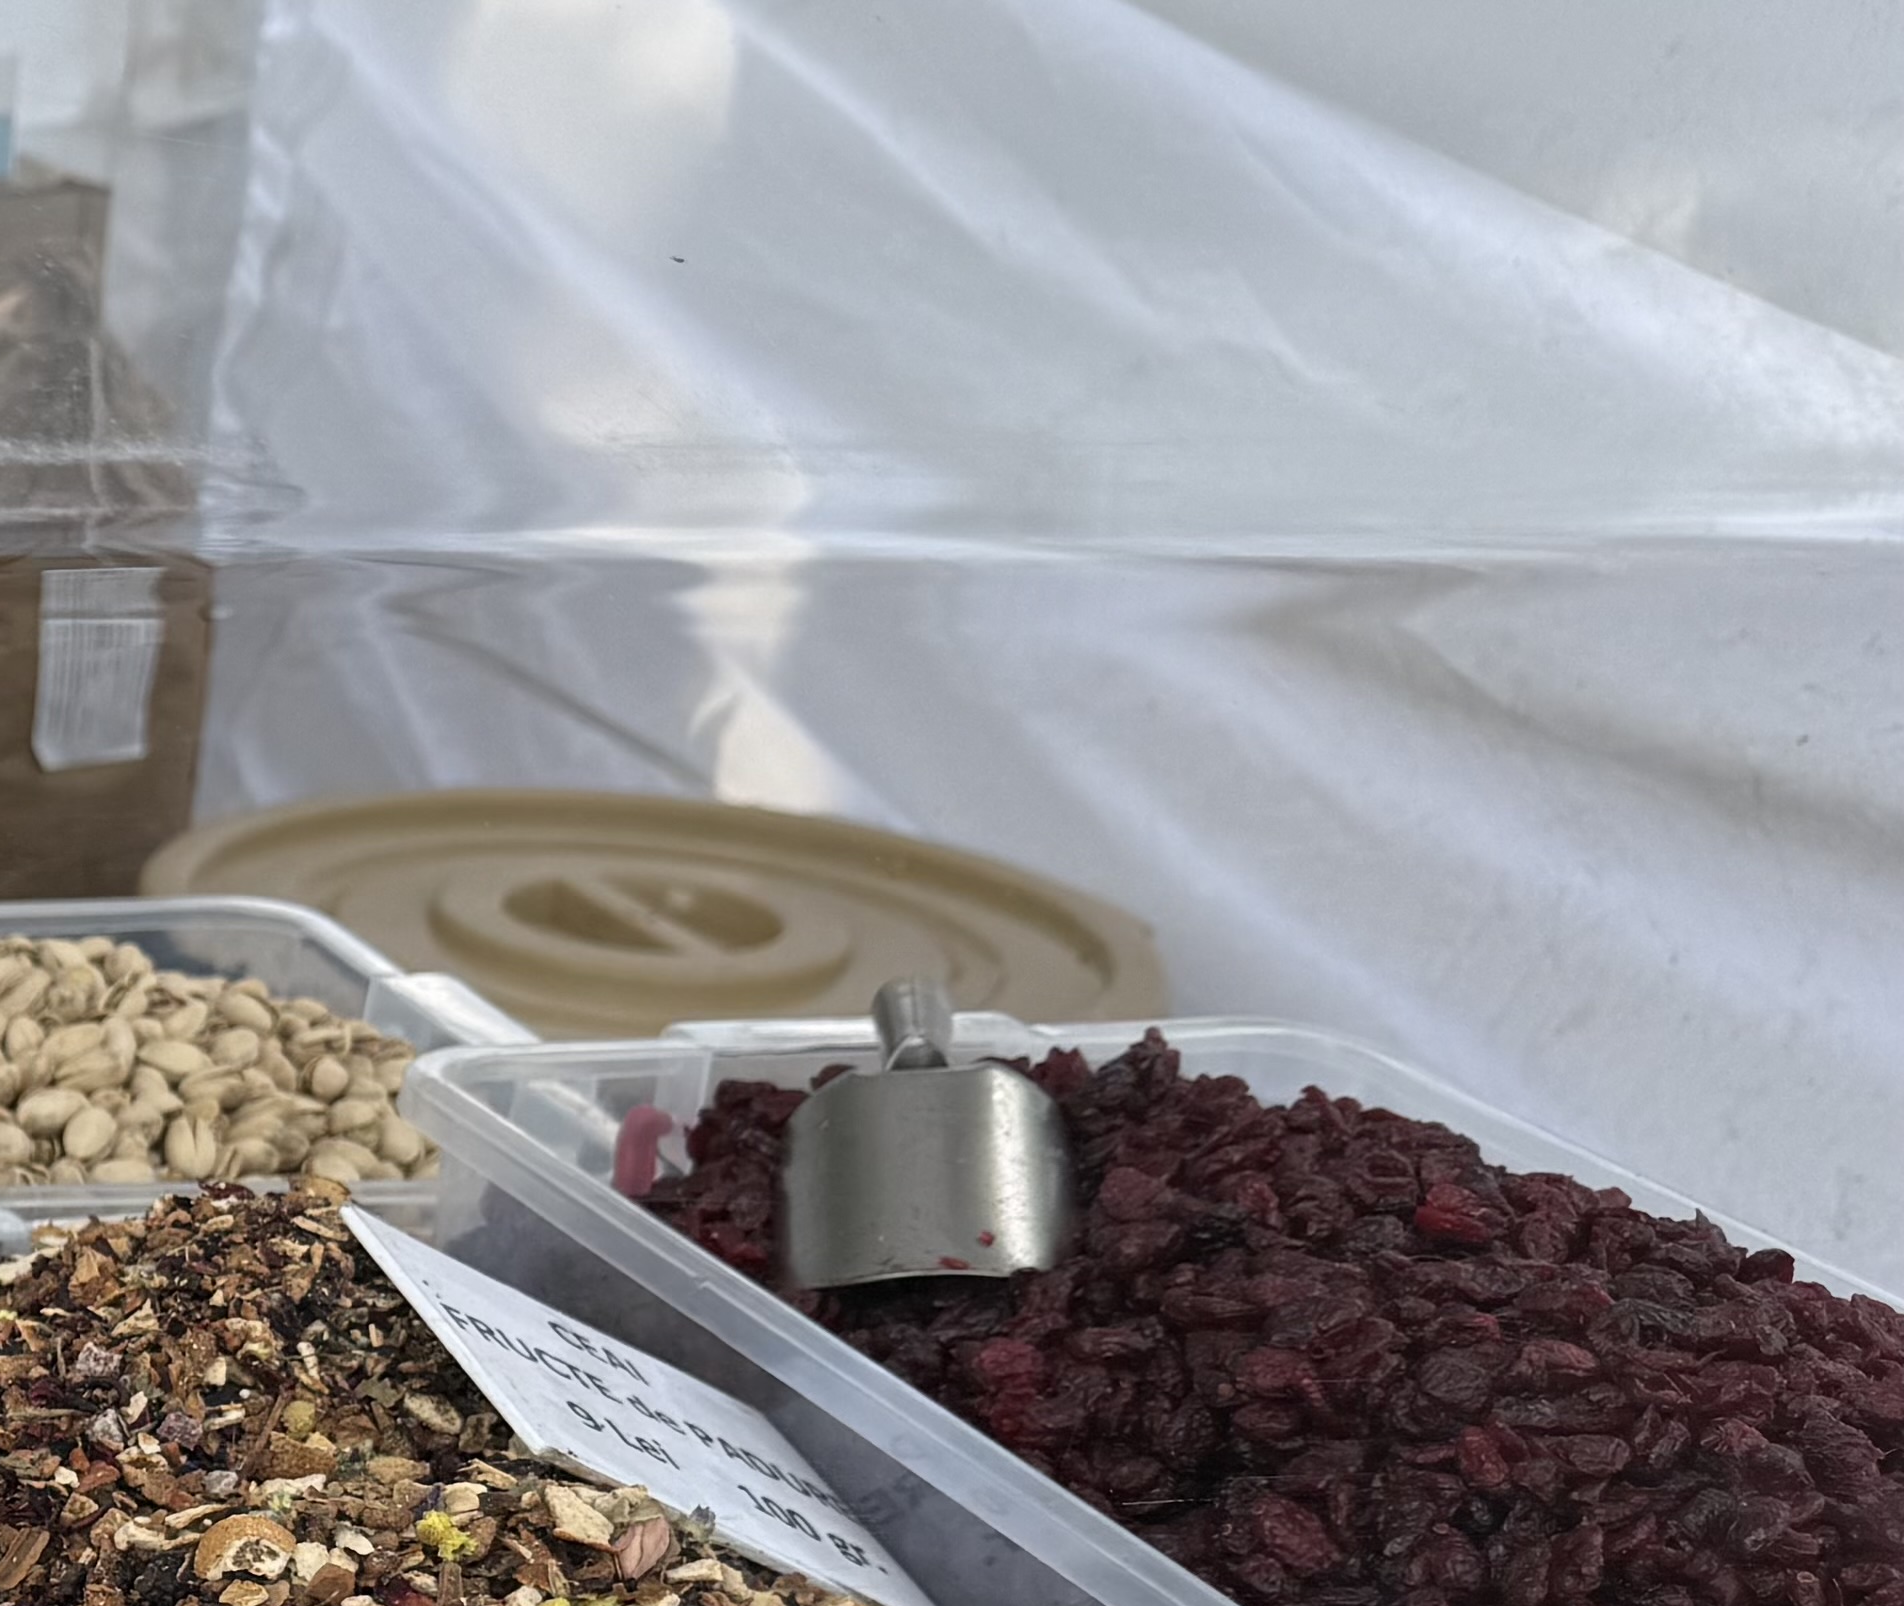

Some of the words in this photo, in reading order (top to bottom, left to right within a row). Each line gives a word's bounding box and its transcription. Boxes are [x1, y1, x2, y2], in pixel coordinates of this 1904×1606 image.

[439, 1302, 624, 1405] FRUCTE
[627, 1395, 687, 1436] de
[547, 1320, 650, 1387] CEAI
[565, 1400, 605, 1432] 9
[603, 1417, 681, 1471] Lei
[737, 1484, 822, 1542] 100
